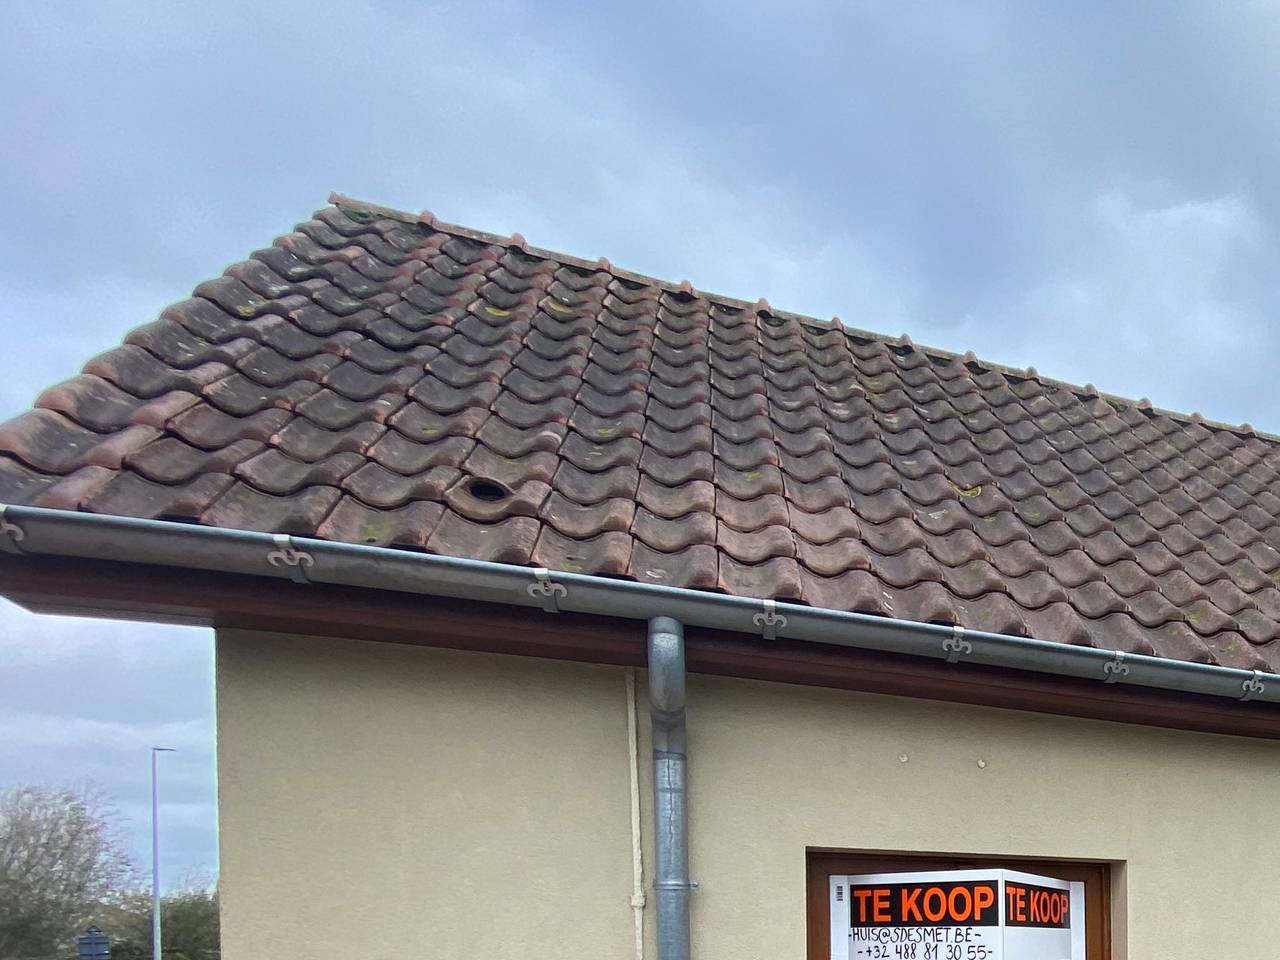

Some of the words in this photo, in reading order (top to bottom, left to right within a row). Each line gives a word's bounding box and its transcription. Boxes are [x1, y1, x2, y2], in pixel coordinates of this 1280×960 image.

[853, 889, 892, 922] TE
[901, 886, 995, 922] KOOP
[1006, 886, 1026, 921] TE
[1030, 889, 1069, 924] KOOP
[895, 943, 917, 960] 488
[924, 943, 938, 960] 81
[946, 945, 962, 960] 30
